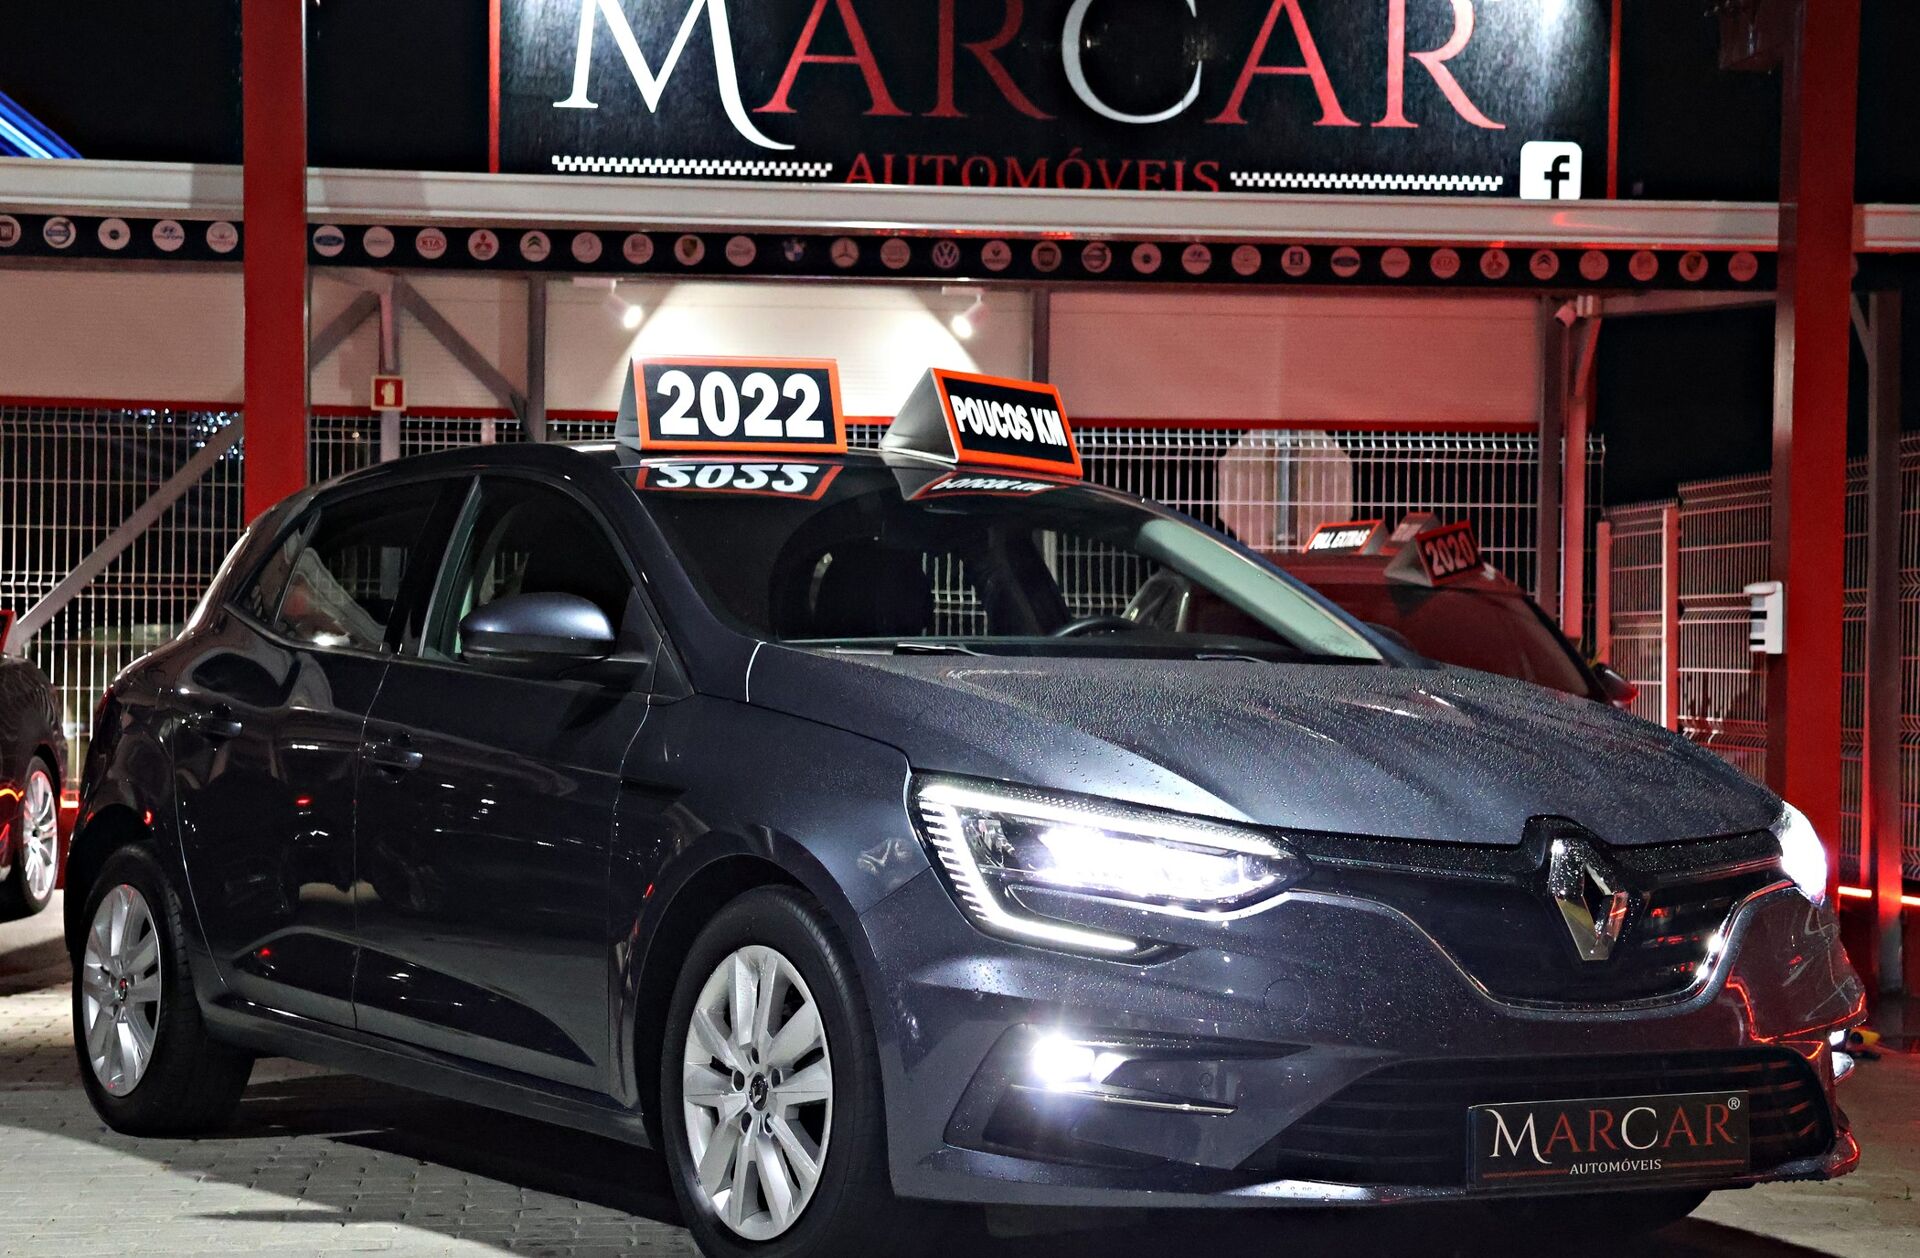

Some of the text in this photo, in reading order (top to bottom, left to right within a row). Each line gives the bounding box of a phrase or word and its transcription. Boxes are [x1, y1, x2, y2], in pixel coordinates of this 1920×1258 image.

[656, 370, 825, 438] 2022
[950, 395, 1068, 446] POUCOS KM
[1425, 531, 1476, 576] 2020
[1569, 1158, 1662, 1175] AUTOMÓVEIS
